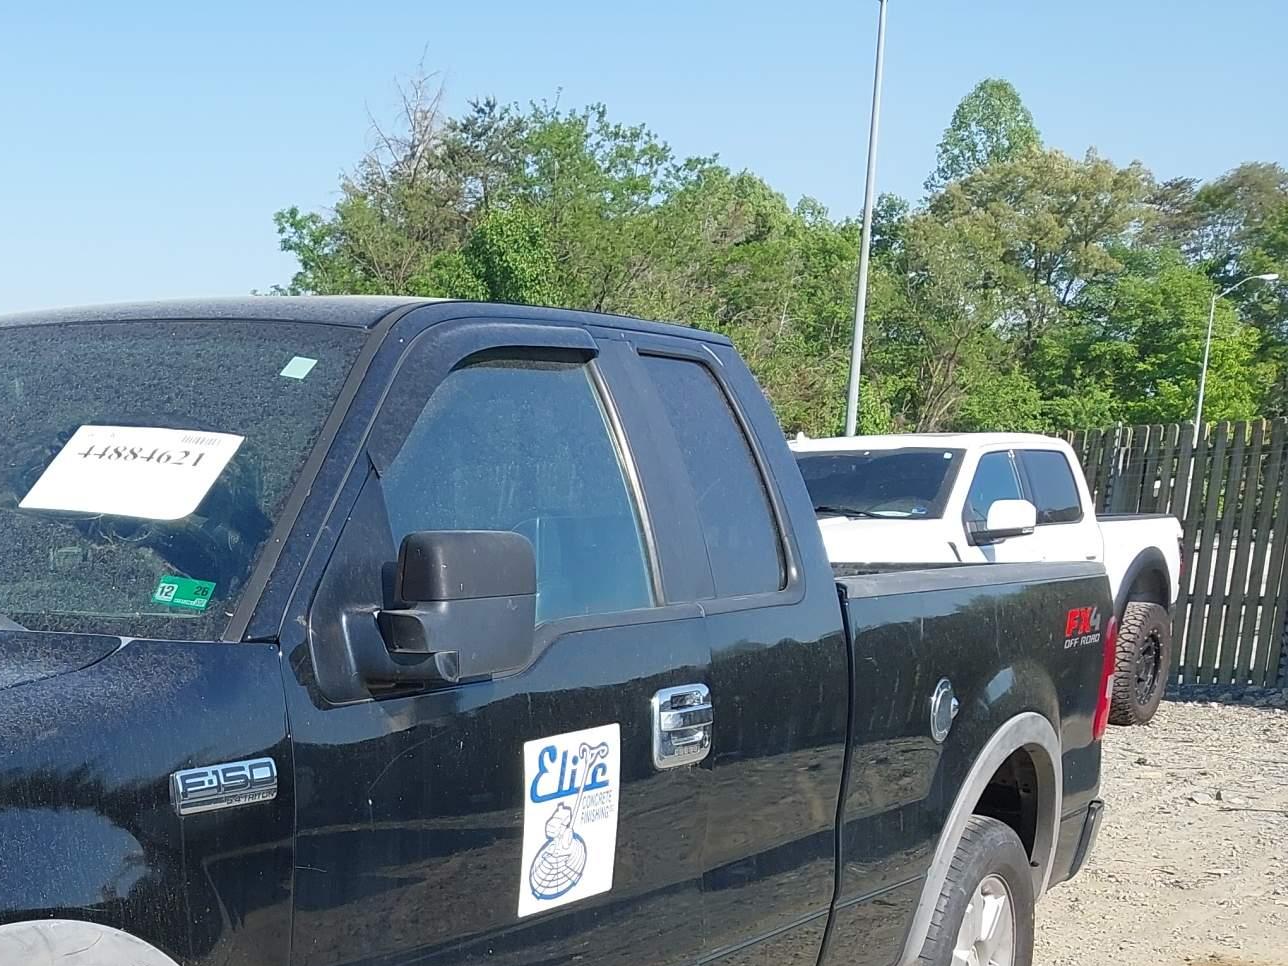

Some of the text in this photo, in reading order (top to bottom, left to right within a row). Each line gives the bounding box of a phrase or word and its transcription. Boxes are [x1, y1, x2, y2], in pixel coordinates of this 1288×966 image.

[78, 445, 204, 466] 44884621
[159, 585, 210, 597] 12 26
[1065, 607, 1101, 637] FX4
[1064, 633, 1101, 649] OFF ROAD
[243, 788, 277, 803] TRITON
[582, 789, 613, 810] CONCRETE
[581, 804, 610, 825] FINISHING
